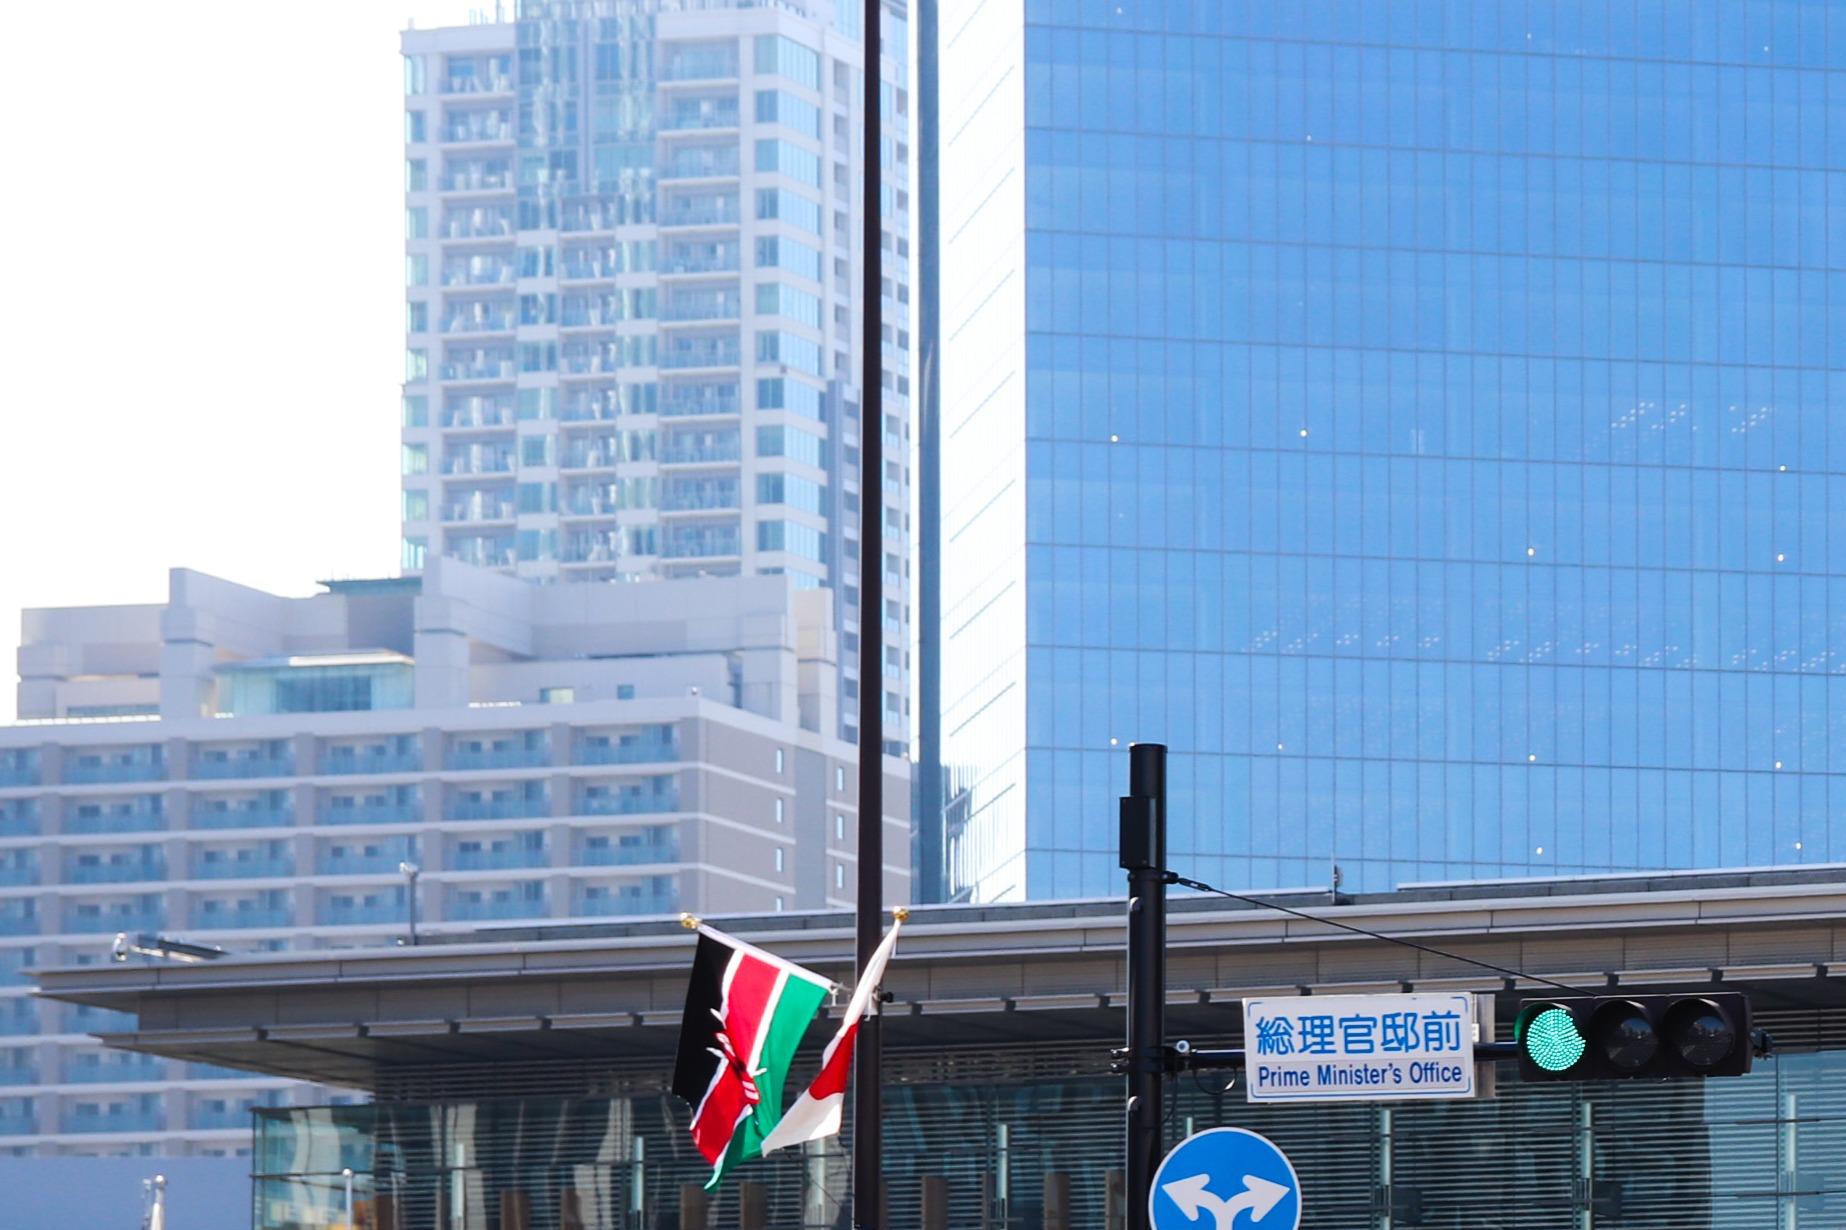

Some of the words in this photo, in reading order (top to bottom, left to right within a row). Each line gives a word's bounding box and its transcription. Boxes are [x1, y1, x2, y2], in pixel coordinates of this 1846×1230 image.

[1255, 1010, 1462, 1056] 総理官邸前
[1259, 1066, 1310, 1087] Prime
[1317, 1063, 1402, 1085] Minister's
[1409, 1061, 1462, 1083] Office
